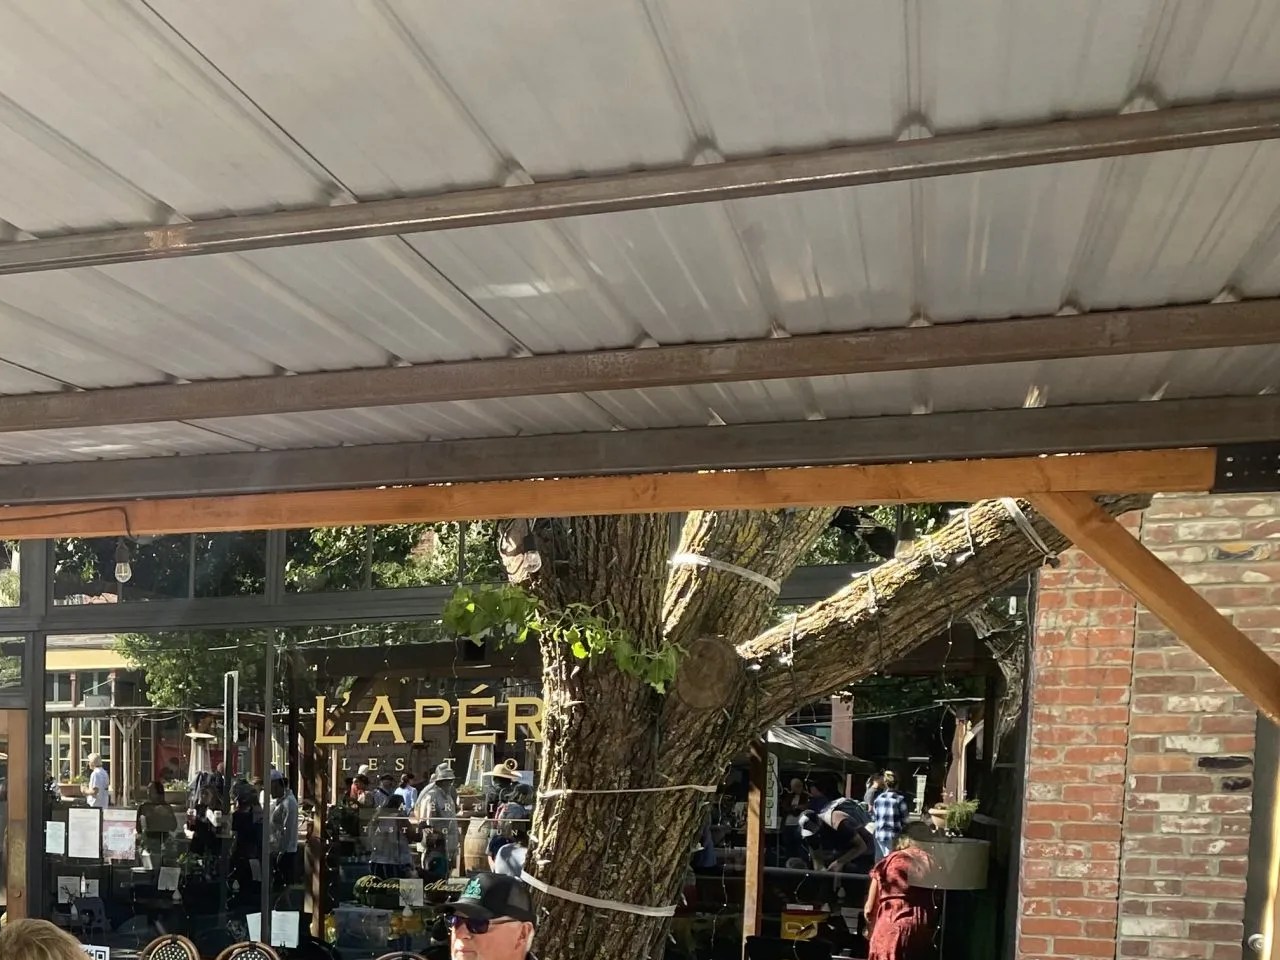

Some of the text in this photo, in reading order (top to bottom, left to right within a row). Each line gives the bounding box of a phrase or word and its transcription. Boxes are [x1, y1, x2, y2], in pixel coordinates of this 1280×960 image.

[314, 683, 544, 745] L'APÉR
[341, 757, 544, 772] LES TROI
